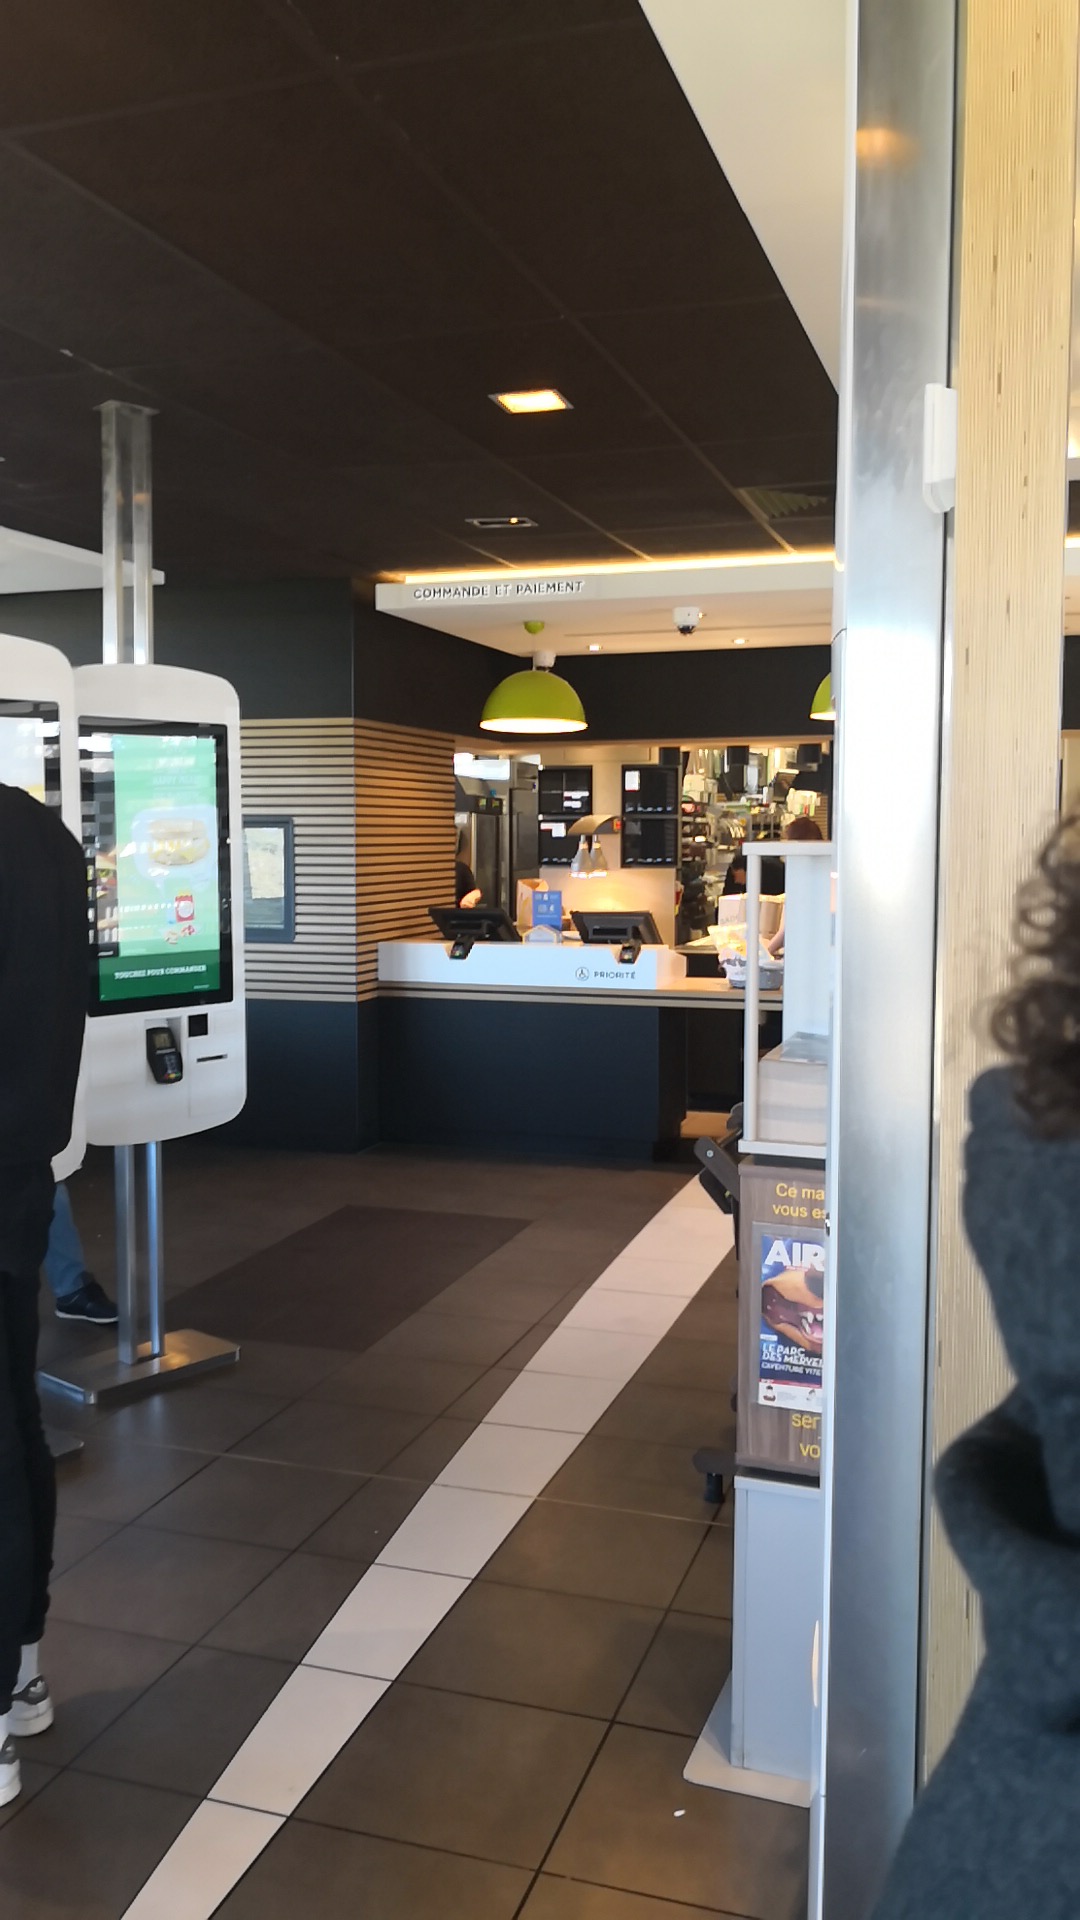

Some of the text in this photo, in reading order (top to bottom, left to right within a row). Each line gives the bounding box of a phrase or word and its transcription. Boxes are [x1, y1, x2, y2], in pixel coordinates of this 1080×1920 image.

[413, 581, 584, 600] COMMANDE ET PAIEMENT
[594, 970, 636, 980] PRIORITÉ
[776, 1183, 798, 1198] Ce
[773, 1204, 808, 1218] vous
[762, 1343, 806, 1357] LE PARC
[762, 1351, 782, 1362] DES
